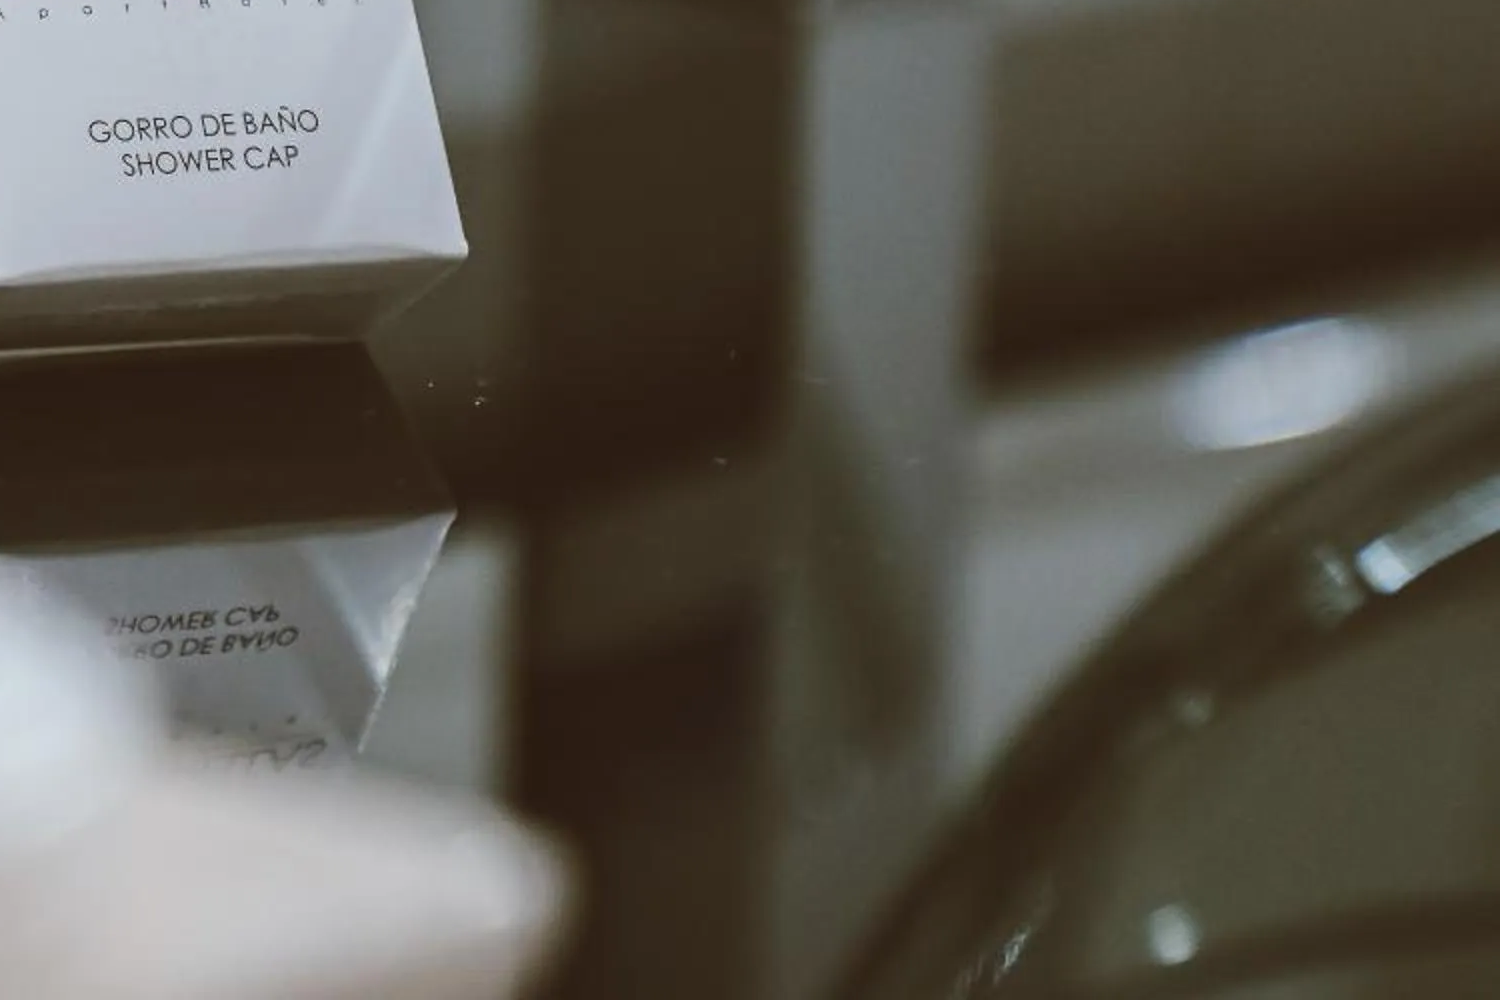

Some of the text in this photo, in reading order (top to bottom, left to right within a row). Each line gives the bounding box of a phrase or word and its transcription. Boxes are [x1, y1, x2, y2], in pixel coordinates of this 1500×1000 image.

[88, 106, 319, 143] GORRO DE BAÑO
[121, 145, 299, 177] SHOWER CAP
